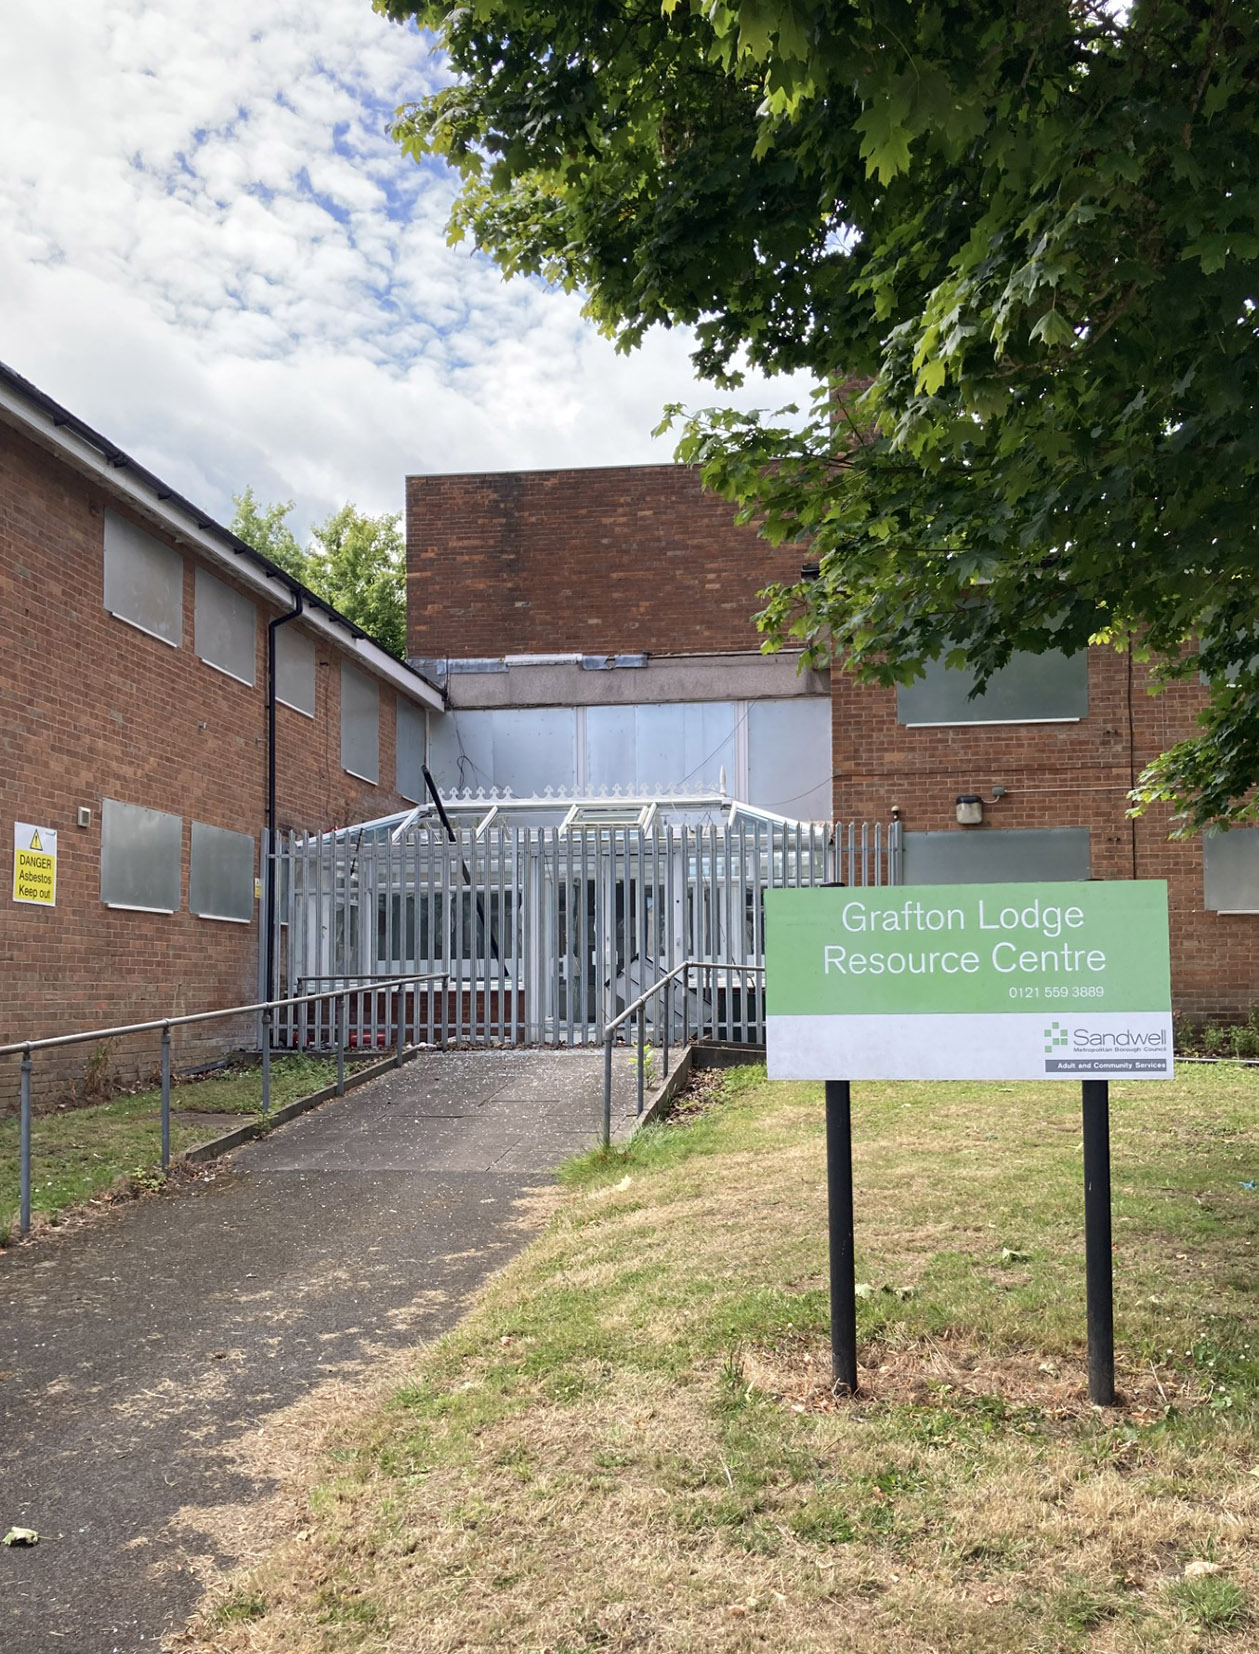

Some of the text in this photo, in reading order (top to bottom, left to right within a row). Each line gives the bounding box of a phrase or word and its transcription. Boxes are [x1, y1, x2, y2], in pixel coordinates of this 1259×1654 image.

[19, 854, 52, 870] DANGER
[19, 869, 52, 885] Asbestos
[18, 884, 51, 899] Keep out
[842, 899, 1084, 937] Grafton Lodge
[824, 942, 1107, 974] Resource Centre
[1009, 986, 1104, 998] 0121 559 3889
[1073, 1028, 1167, 1046] Sandwell
[1093, 1062, 1133, 1070] Community
